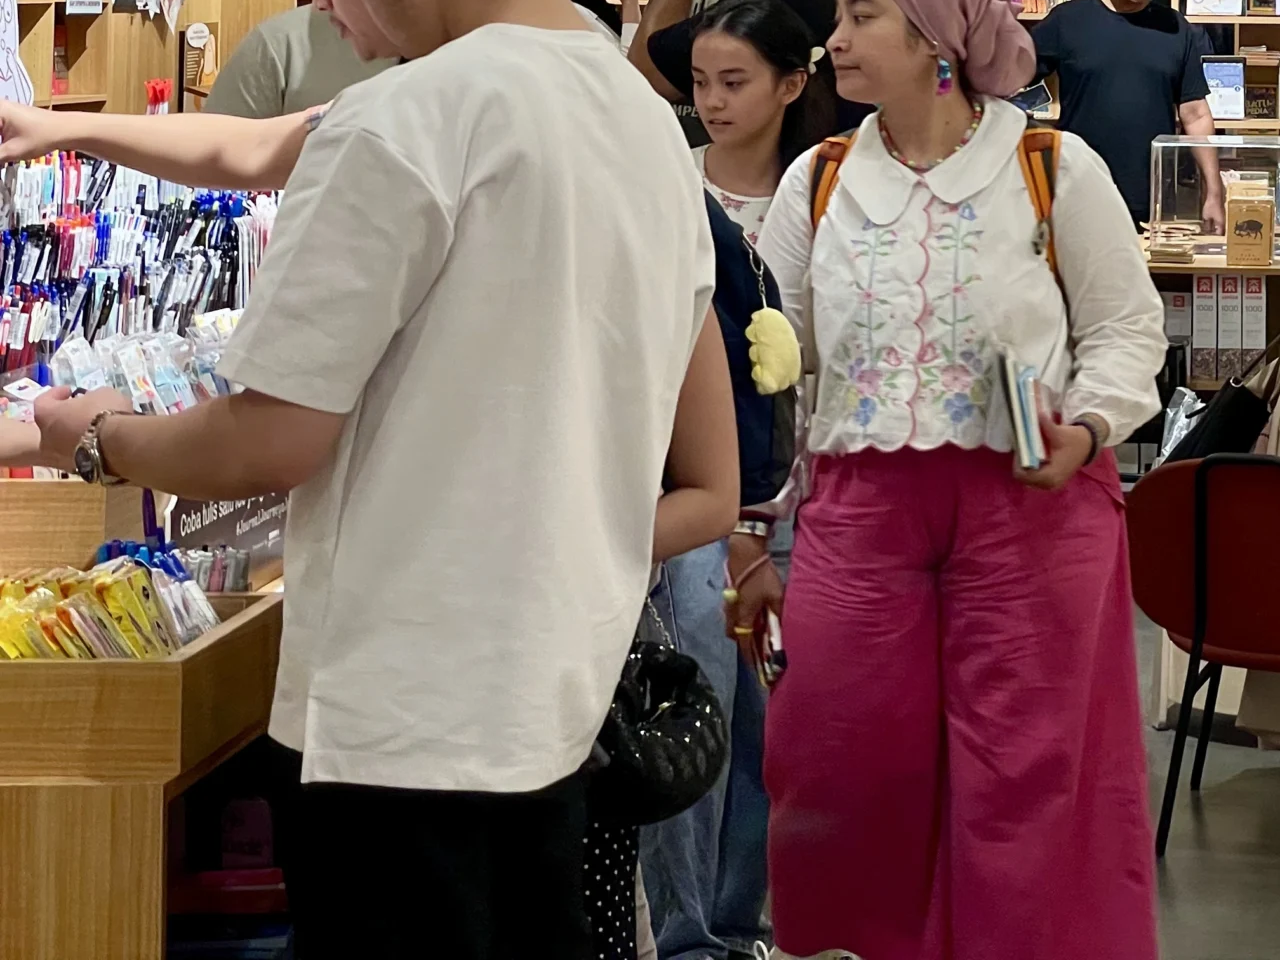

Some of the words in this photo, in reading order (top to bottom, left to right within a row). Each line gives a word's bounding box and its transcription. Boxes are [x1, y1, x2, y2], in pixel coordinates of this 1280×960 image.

[1196, 304, 1214, 312] 1000
[1221, 304, 1239, 312] 1000
[1245, 305, 1263, 313] 1000
[180, 509, 202, 537] Coba
[202, 501, 218, 527] tulis
